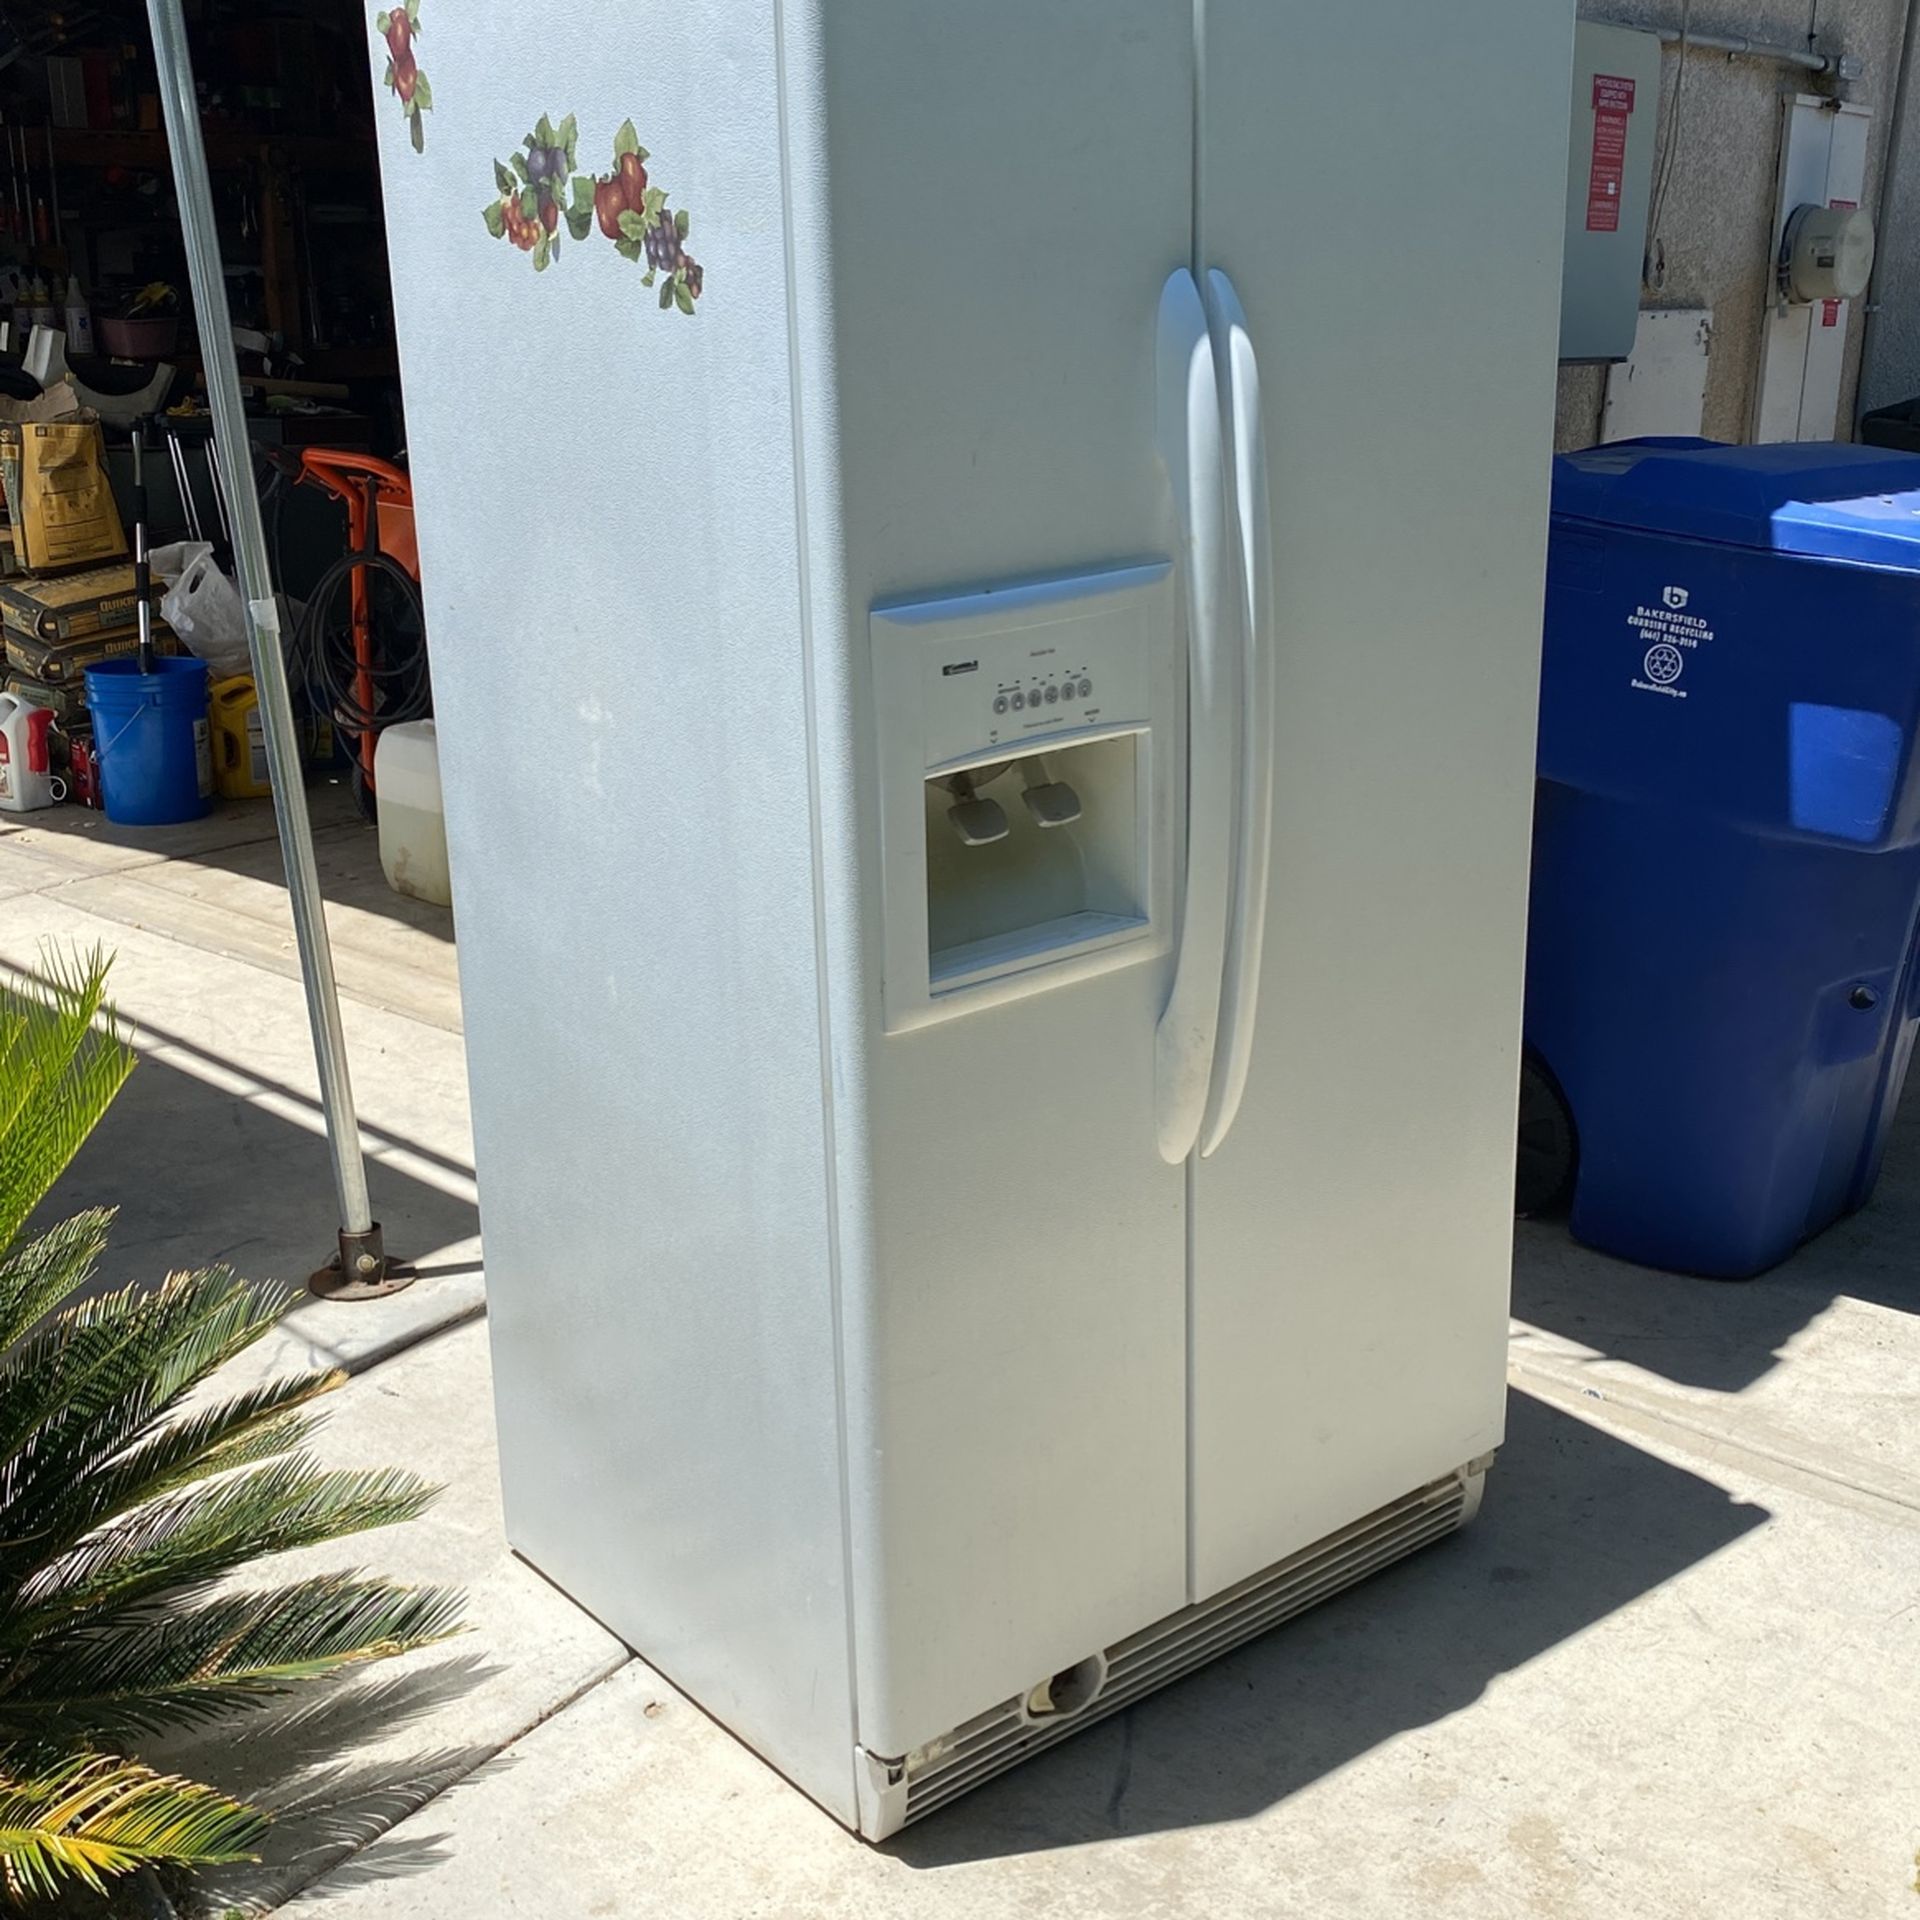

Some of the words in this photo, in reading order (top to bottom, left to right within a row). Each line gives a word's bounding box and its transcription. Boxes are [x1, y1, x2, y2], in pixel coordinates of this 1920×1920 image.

[100, 595, 138, 612] QUIKR
[1627, 615, 1667, 631] CURBSIDE
[1669, 623, 1714, 641] RECYCLING
[1637, 606, 1707, 629] BAKERSFIELD
